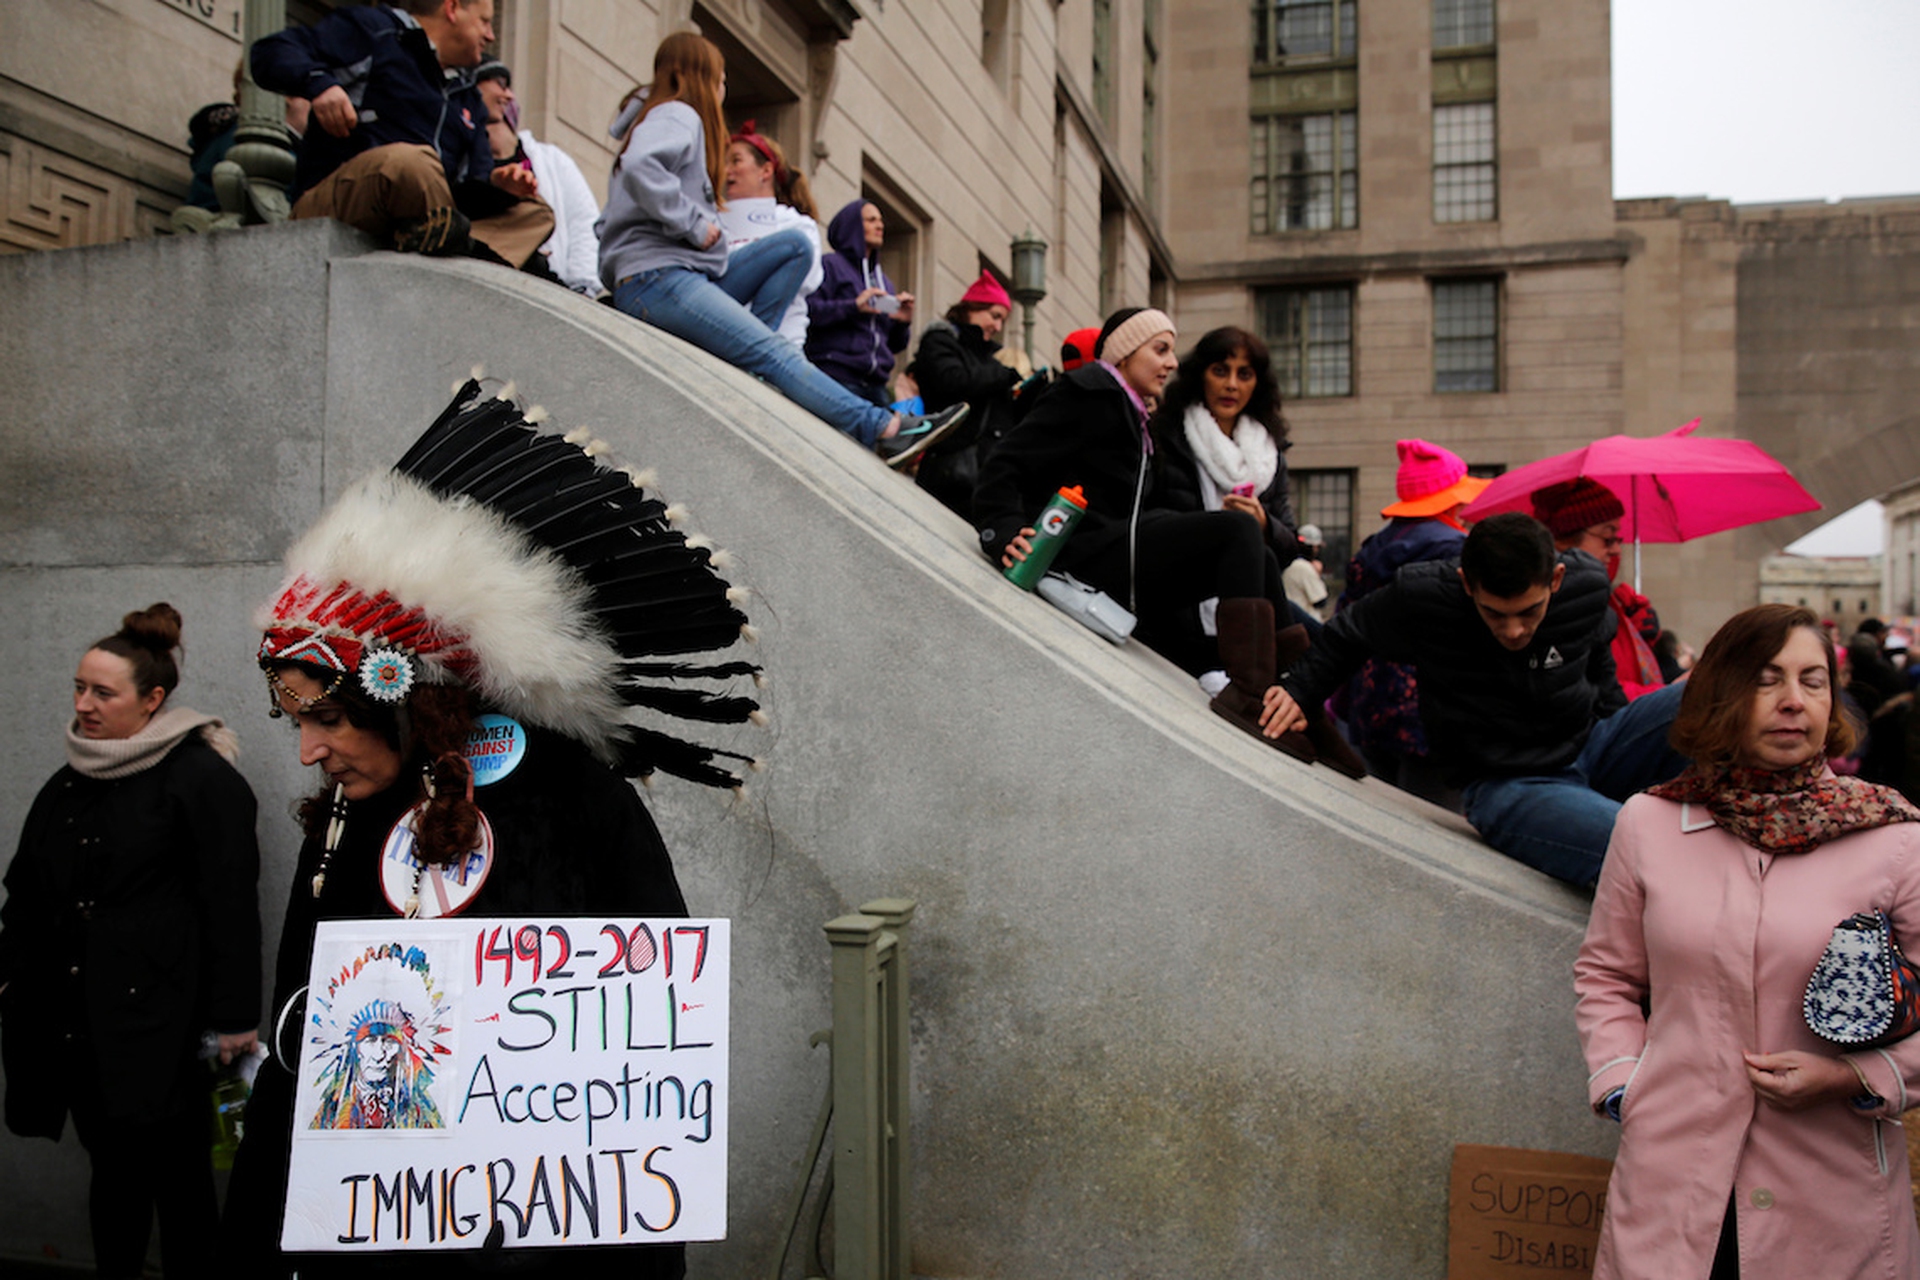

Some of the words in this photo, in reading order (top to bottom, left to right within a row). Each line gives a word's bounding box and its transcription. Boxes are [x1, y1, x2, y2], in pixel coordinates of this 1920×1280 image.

[1042, 508, 1070, 536] G
[462, 738, 516, 757] GAINST
[465, 725, 514, 742] OMEN
[468, 755, 508, 771] UMP
[475, 922, 710, 987] 1492-2017
[498, 982, 714, 1052] STILL
[458, 1053, 714, 1147] Accepting
[337, 1146, 682, 1244] IMMIGRANTS
